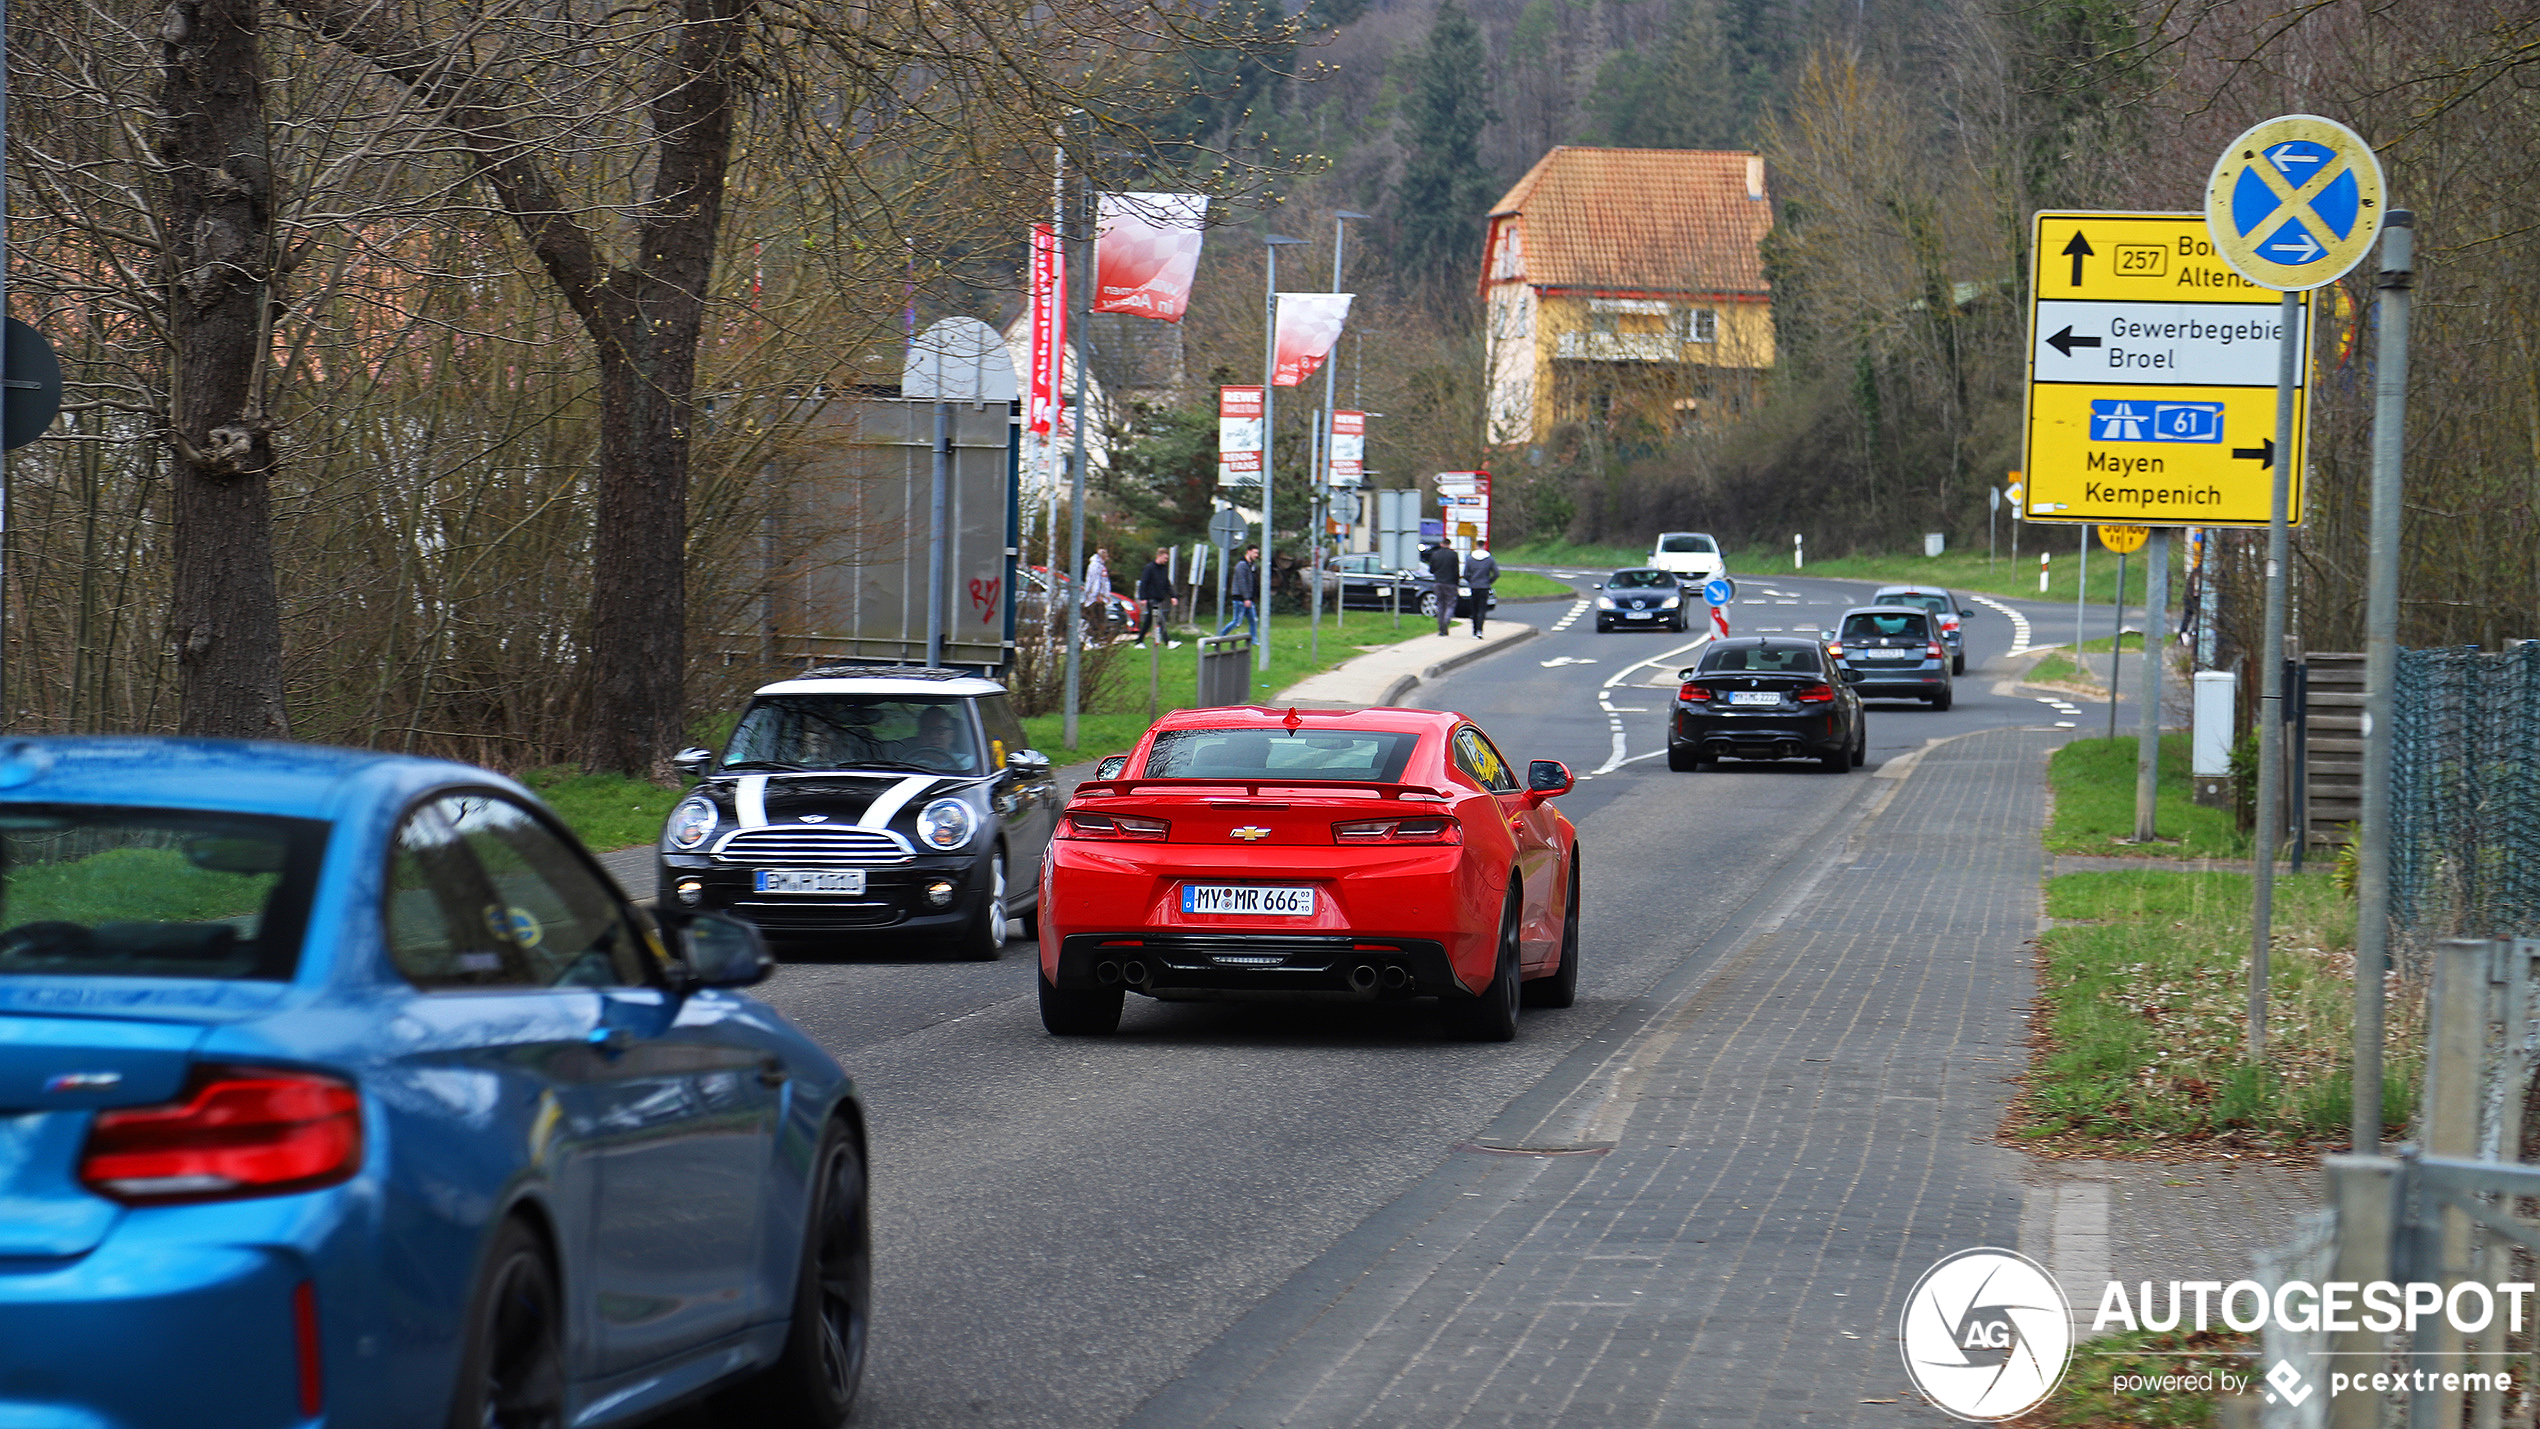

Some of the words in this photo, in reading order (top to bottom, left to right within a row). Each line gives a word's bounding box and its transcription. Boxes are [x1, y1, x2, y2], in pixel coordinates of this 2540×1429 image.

[2123, 251, 2159, 270] 257
[2177, 267, 2262, 288] Altena
[2111, 317, 2283, 345] Gewerbegebie
[2109, 347, 2174, 369] Broel
[2173, 412, 2197, 433] 61
[2087, 451, 2165, 478] Mayen
[2085, 482, 2222, 508] Kempenich
[1197, 888, 1221, 909] MY
[1234, 889, 1258, 910] MR
[1263, 890, 1298, 911] 666
